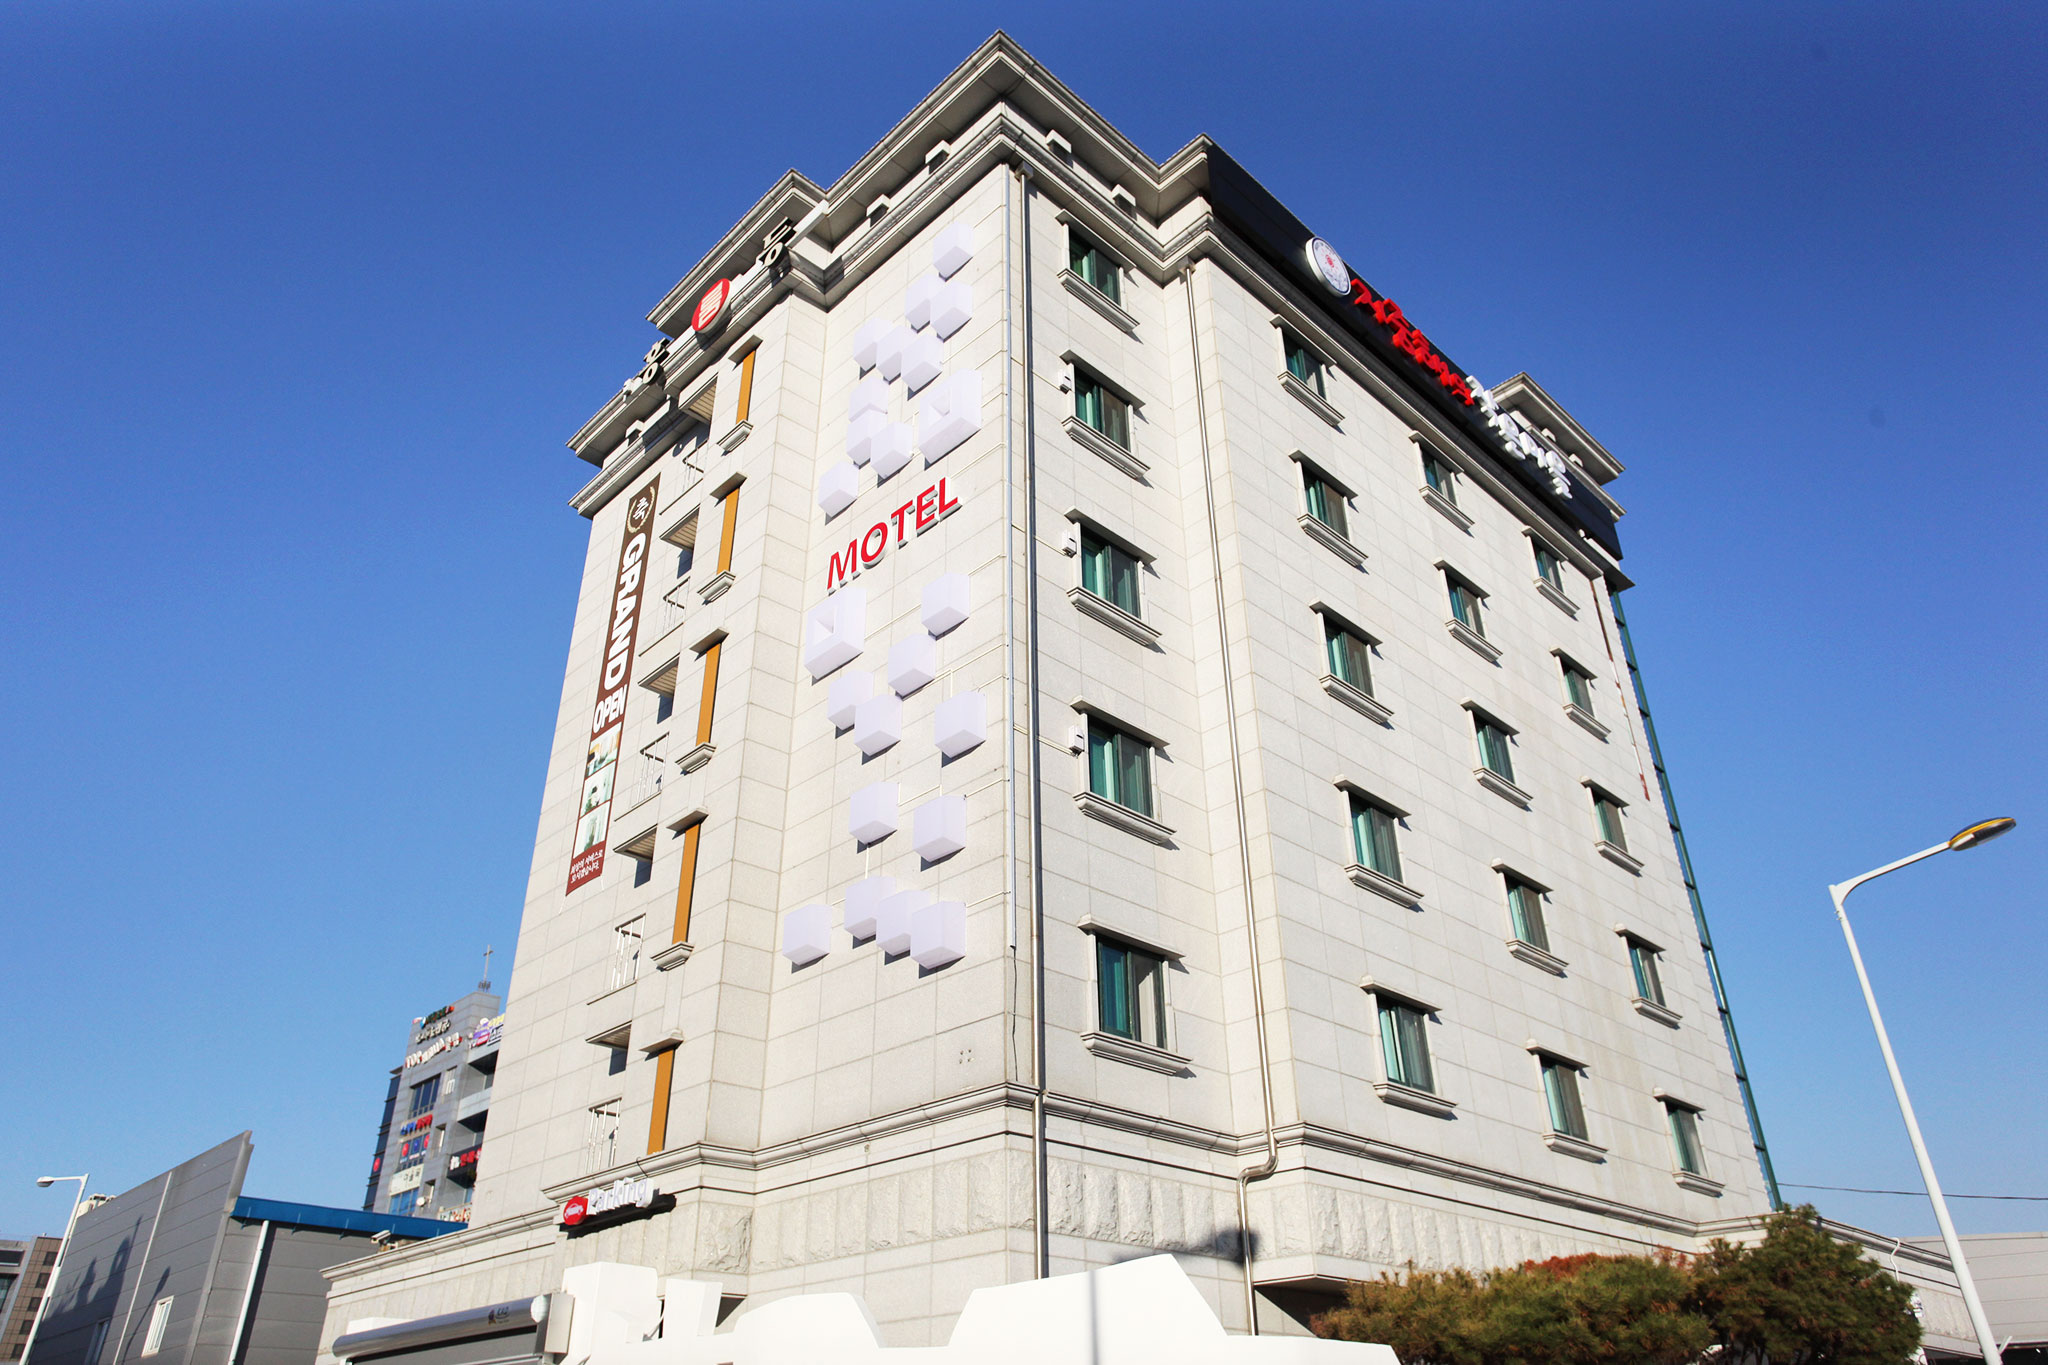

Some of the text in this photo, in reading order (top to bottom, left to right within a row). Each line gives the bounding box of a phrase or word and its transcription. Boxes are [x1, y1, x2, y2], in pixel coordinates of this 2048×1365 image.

[1466, 375, 1573, 499] 작은마을
[826, 476, 961, 594] MOTEL
[593, 532, 647, 734] GRAND OPEN
[586, 1177, 654, 1216] Parking
